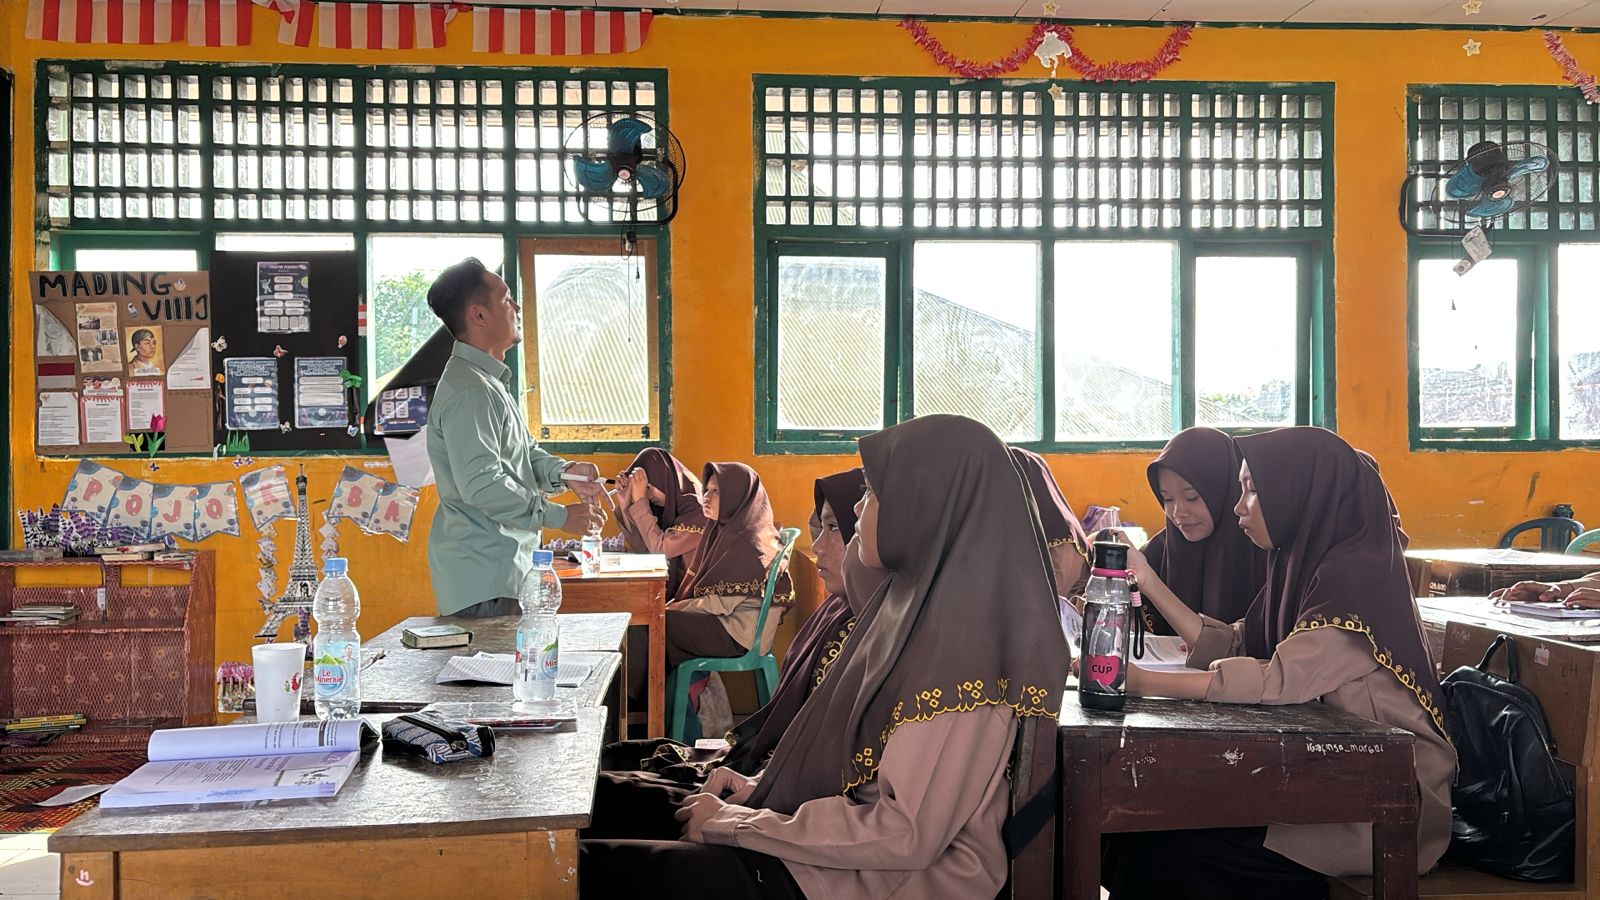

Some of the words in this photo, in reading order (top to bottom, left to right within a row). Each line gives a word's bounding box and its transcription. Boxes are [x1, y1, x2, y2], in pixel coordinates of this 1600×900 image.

[39, 271, 172, 297] MADING
[1092, 664, 1113, 674] CUP
[314, 675, 344, 683] Minerale
